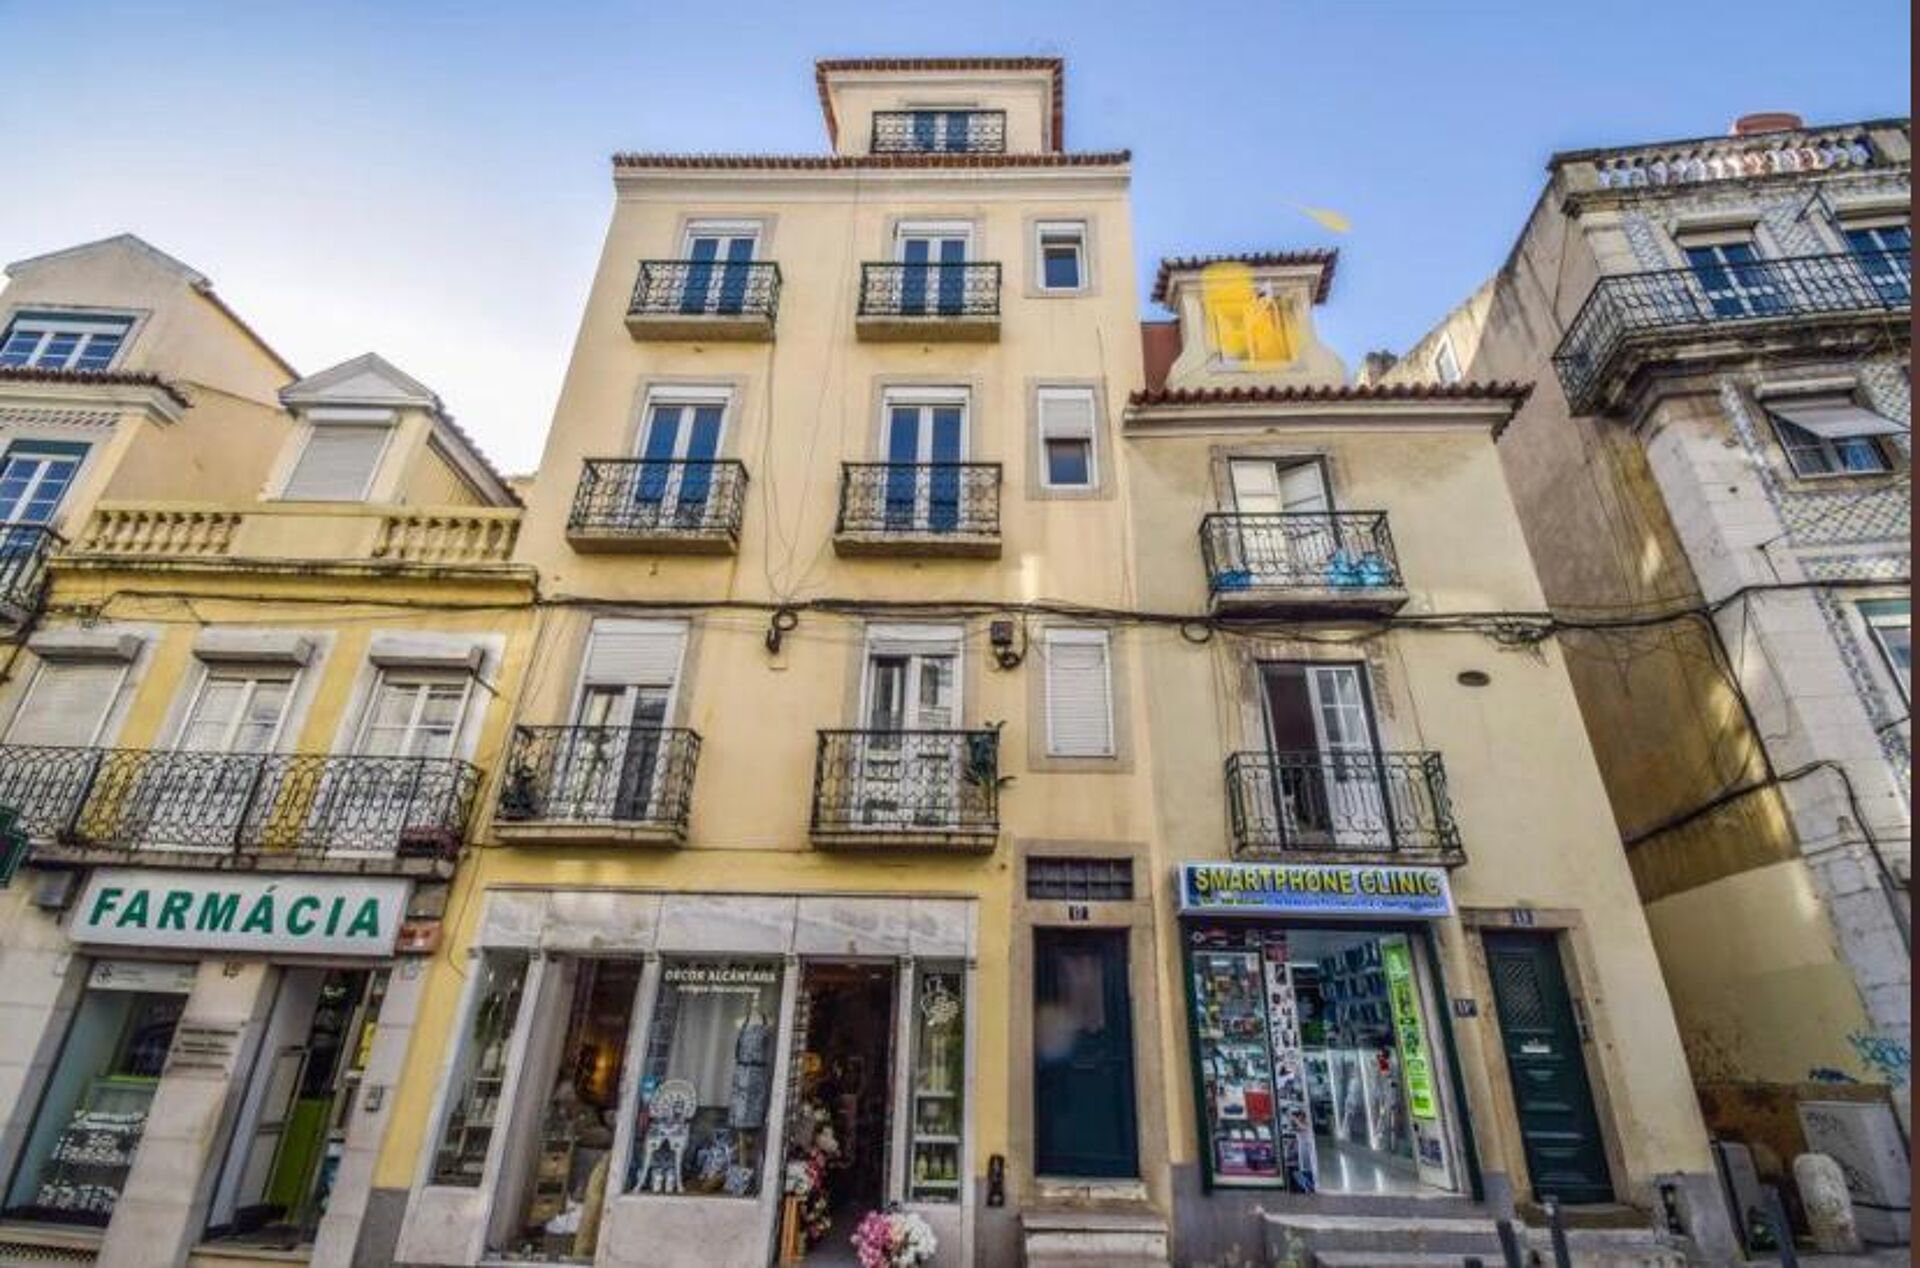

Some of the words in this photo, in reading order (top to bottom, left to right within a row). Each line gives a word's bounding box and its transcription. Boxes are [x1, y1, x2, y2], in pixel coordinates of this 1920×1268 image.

[1195, 867, 1356, 894] SMARTPHONE
[1359, 870, 1442, 896] CLINIC
[89, 885, 380, 938] FARMÁCIA
